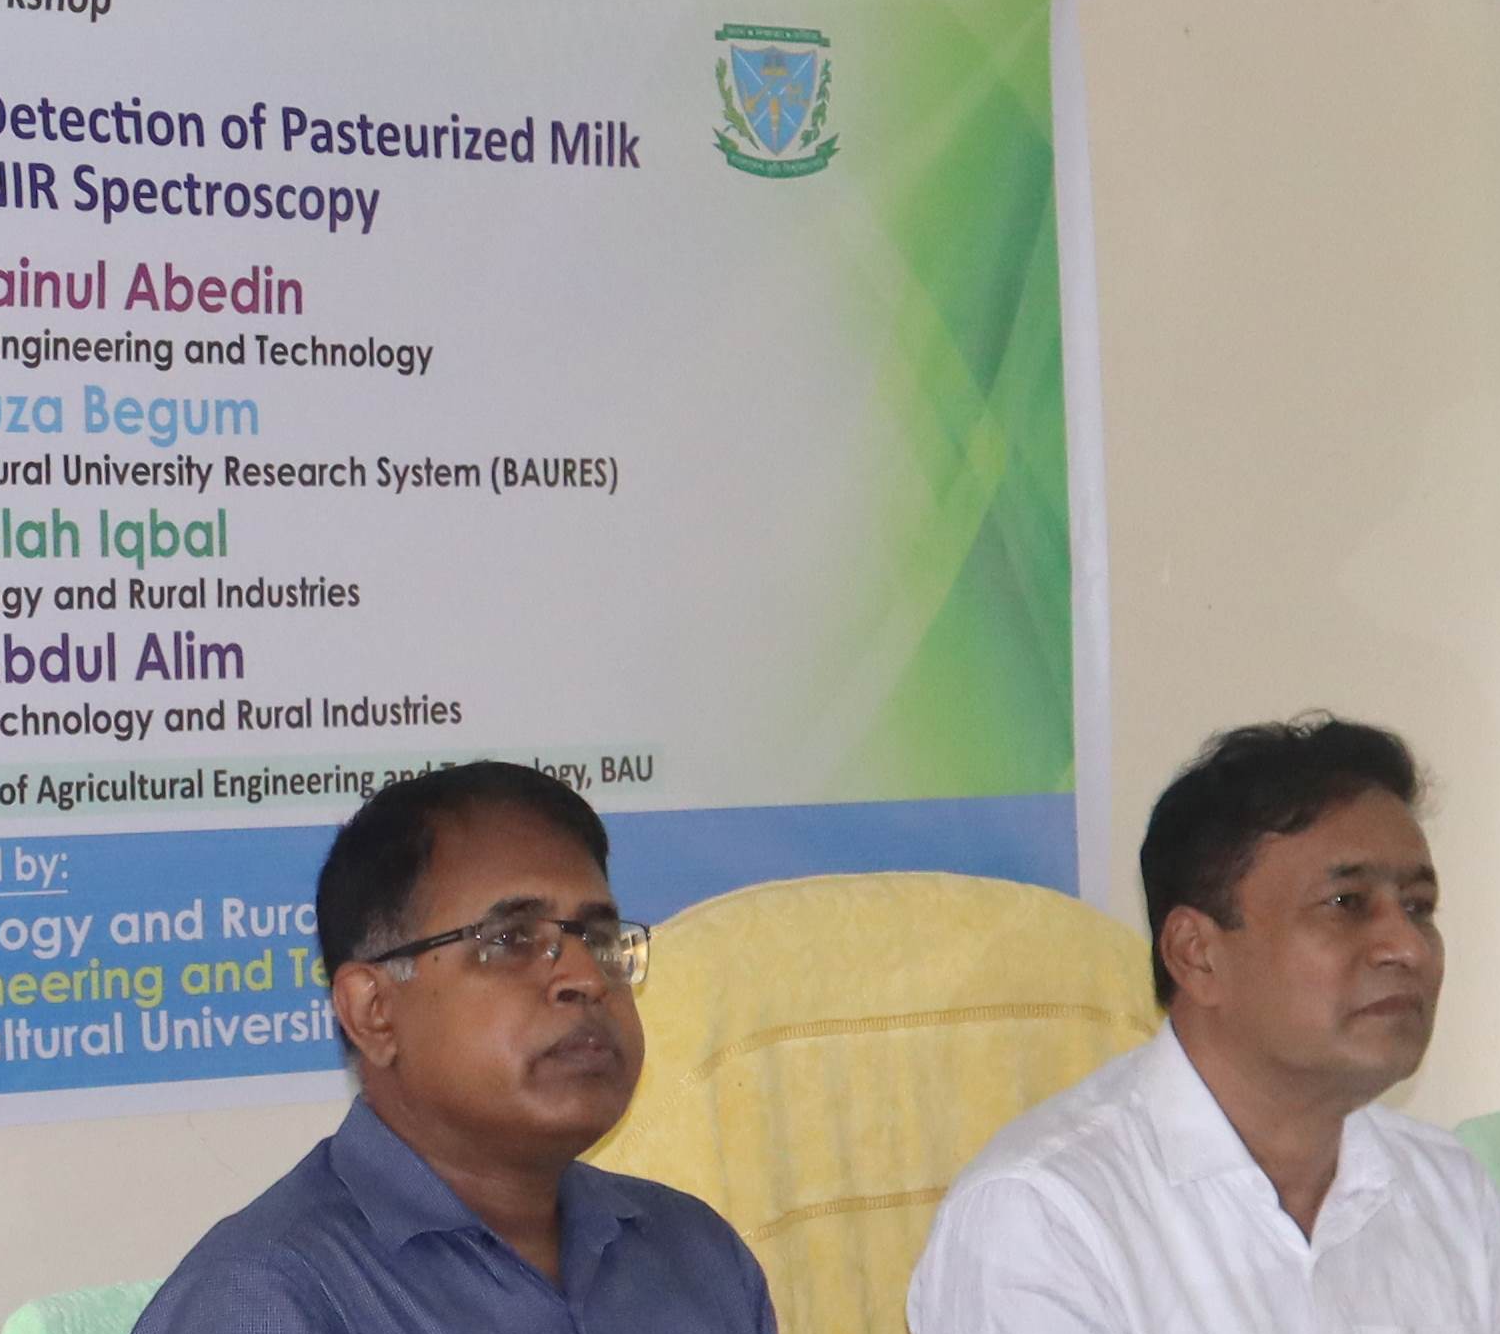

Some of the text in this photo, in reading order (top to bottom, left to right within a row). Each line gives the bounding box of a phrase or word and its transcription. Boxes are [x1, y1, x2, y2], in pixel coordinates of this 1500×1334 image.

[221, 101, 266, 151] of
[282, 107, 534, 163] Pasteurized
[551, 120, 640, 168] Milk
[74, 165, 380, 233] Spectroscopy
[125, 262, 302, 315] Abedin
[185, 333, 245, 365] and
[255, 334, 433, 376] Technology
[84, 385, 258, 447] Begum
[63, 455, 213, 494] University
[225, 455, 366, 488] Research
[377, 456, 480, 494] System
[491, 456, 617, 495] (BAURES)
[100, 508, 227, 570] Iqbal
[135, 630, 244, 681] Alim
[165, 699, 225, 733] and
[238, 697, 312, 731] Rural
[323, 695, 462, 728] Industries
[0, 773, 28, 807] of
[37, 769, 203, 812] Agricultural
[214, 765, 375, 805] Engineering
[600, 755, 654, 784] BAU
[16, 846, 67, 895] by:
[110, 898, 202, 944] and
[223, 896, 318, 939] Rura
[181, 950, 274, 995] and
[138, 998, 336, 1053] Universit
